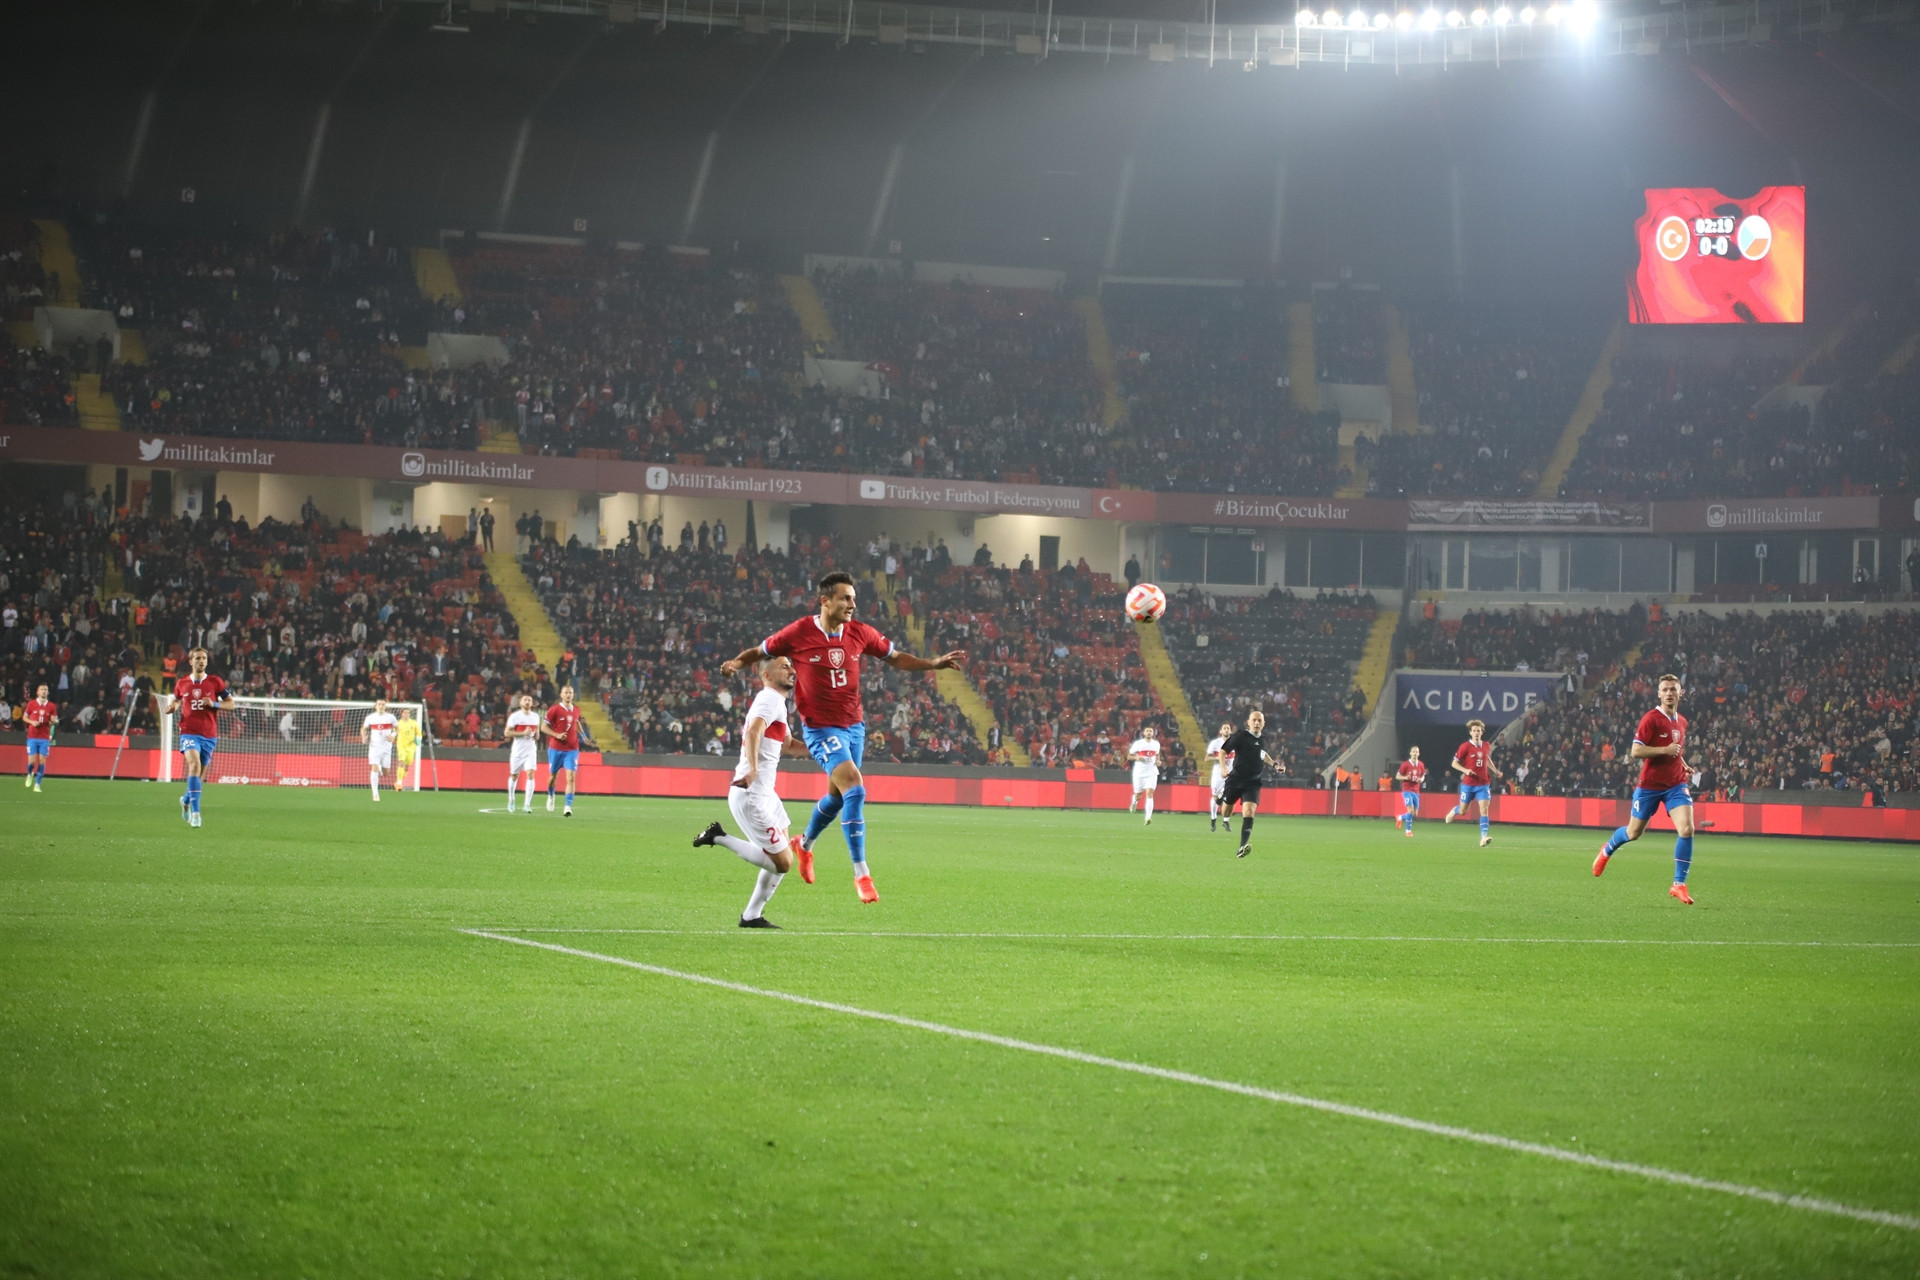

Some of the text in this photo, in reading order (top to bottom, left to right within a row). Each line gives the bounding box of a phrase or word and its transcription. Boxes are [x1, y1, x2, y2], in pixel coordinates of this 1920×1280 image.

[1696, 218, 1734, 234] 02:19
[1700, 236, 1728, 256] 0-0
[164, 443, 276, 466] millitakimlar
[426, 459, 535, 480] millitakimlar
[669, 472, 802, 494] MilliTakimlar1923
[887, 484, 1080, 511] Türkiye Futbol Federasyonu
[1215, 500, 1350, 521] #BizimÇocuklar
[1728, 506, 1824, 525] millitakimlar
[1757, 545, 1765, 556] A
[830, 669, 848, 688] 13
[191, 700, 204, 711] 22
[566, 723, 572, 732] 7
[820, 735, 843, 754] 13
[1633, 800, 1640, 812] 4
